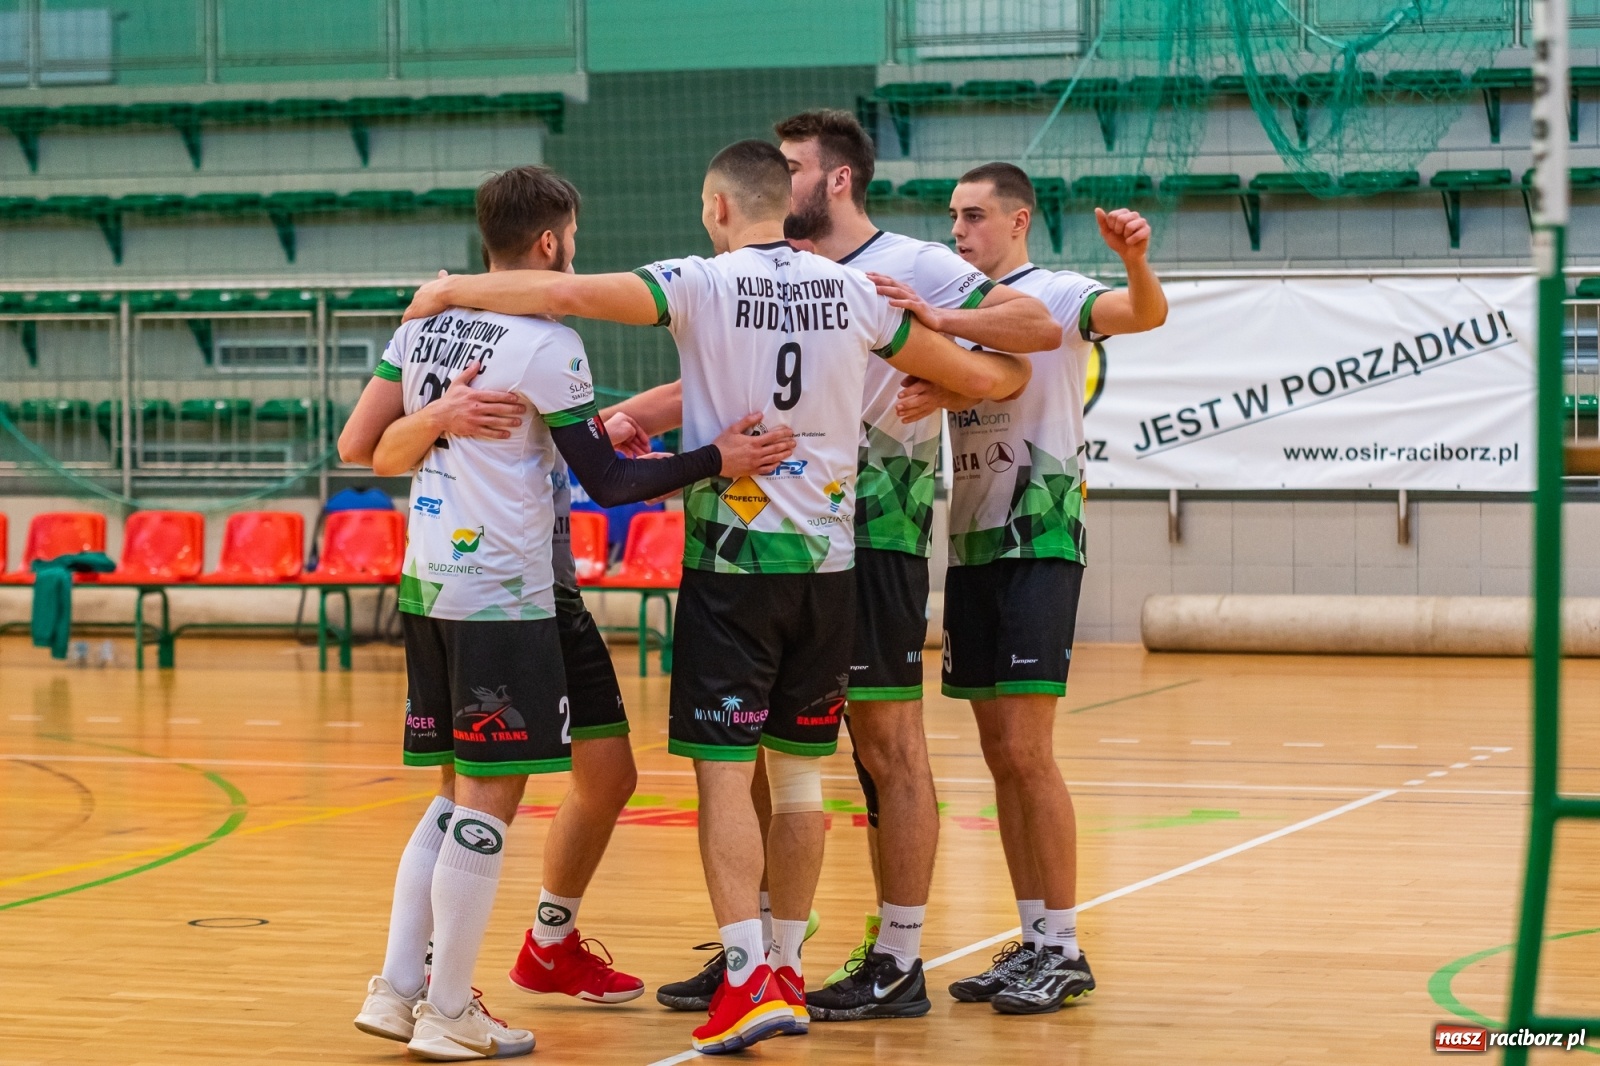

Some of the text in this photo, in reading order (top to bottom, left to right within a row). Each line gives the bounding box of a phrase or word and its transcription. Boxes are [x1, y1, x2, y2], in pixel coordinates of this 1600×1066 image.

[736, 276, 775, 298] KLUB
[735, 299, 849, 334] RUDZINIEC
[773, 341, 802, 411] 9
[1133, 310, 1514, 453] JEST W PORZĄDKU!
[1283, 443, 1519, 466] www.osir-raciborz.pl
[723, 494, 768, 503] PROFECTUS
[428, 562, 483, 575] RUDZINIEC
[694, 708, 725, 722] MIAMI
[491, 731, 529, 742] TRANS
